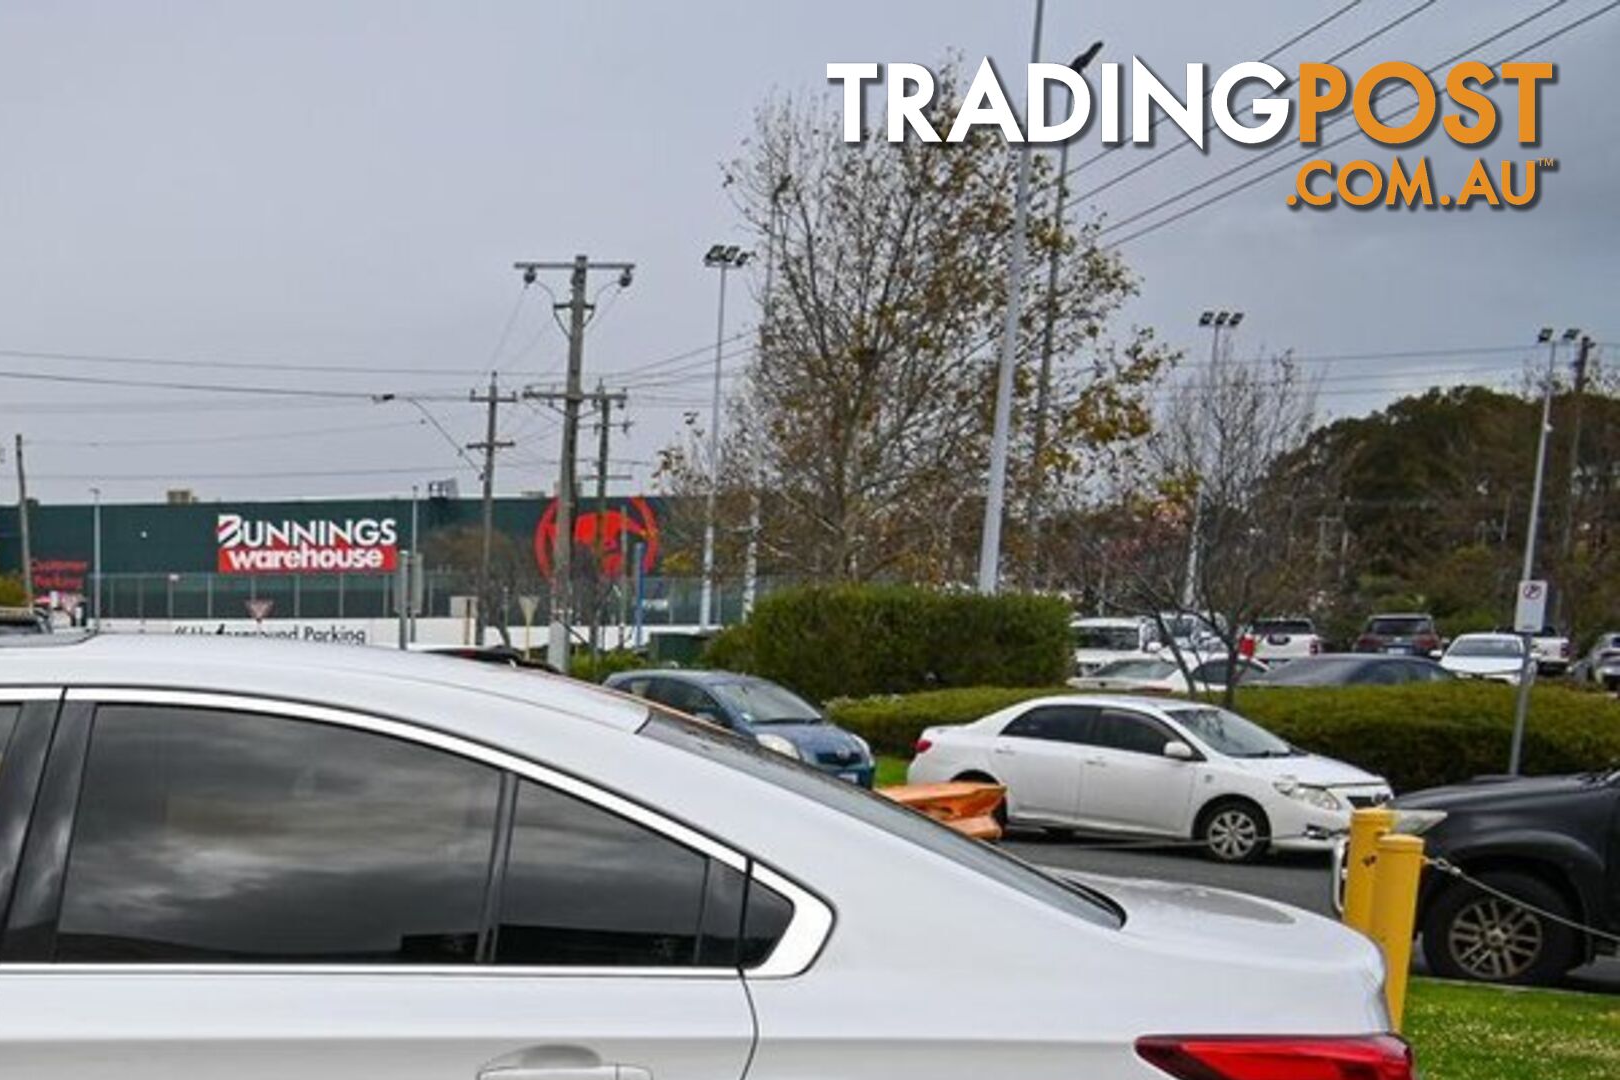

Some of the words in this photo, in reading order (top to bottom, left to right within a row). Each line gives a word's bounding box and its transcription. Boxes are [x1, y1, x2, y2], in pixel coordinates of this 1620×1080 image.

[217, 514, 397, 548] BUNNINGS
[229, 543, 384, 569] warehouse
[304, 624, 366, 646] Parking
